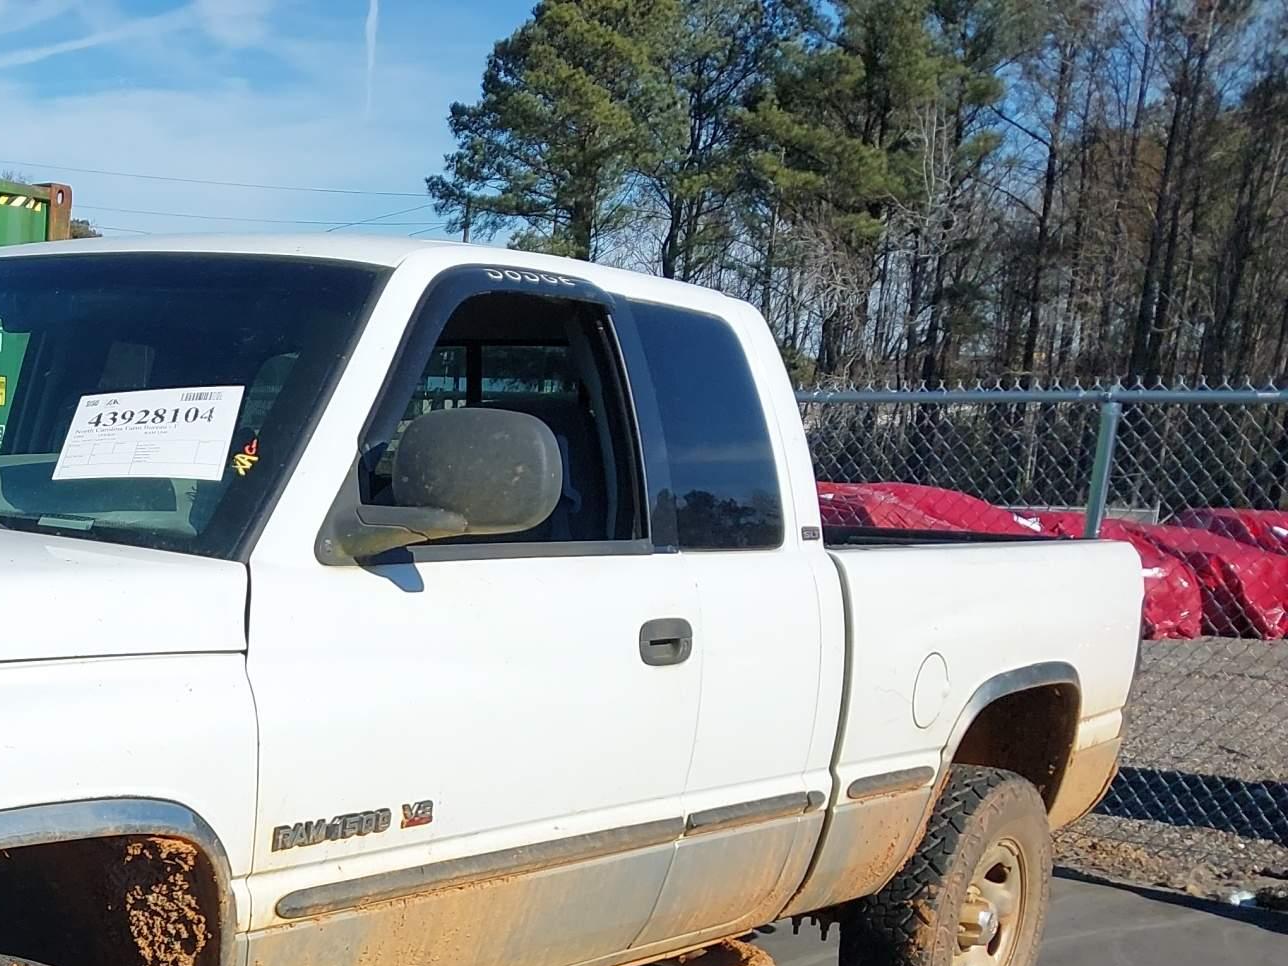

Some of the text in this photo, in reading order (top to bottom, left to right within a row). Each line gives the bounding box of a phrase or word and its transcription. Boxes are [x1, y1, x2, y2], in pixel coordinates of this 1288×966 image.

[87, 406, 215, 428] 43928104
[271, 819, 327, 852] RAM
[325, 807, 392, 841] 1500
